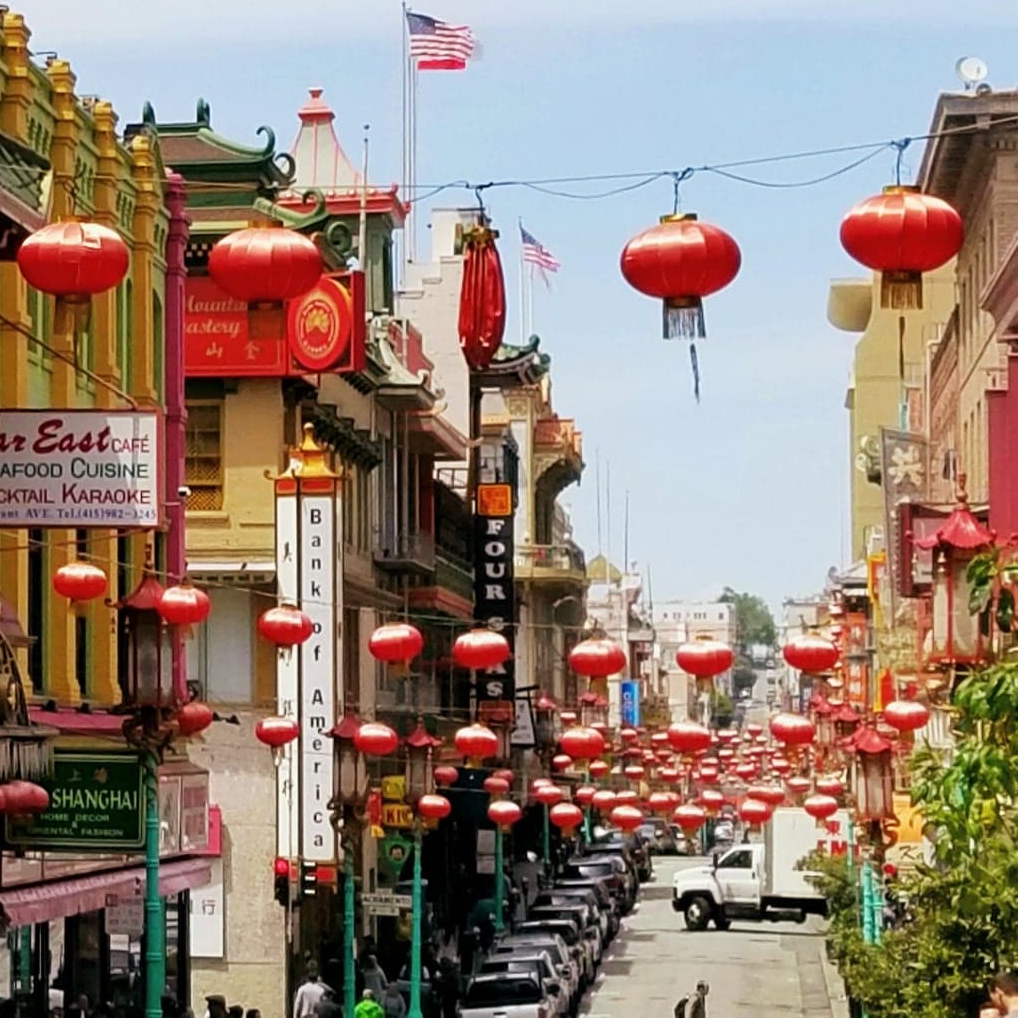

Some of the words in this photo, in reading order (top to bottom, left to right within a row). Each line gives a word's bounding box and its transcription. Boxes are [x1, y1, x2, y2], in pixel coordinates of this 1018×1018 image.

[32, 418, 111, 455] East
[111, 434, 150, 454] CAFÉ
[70, 457, 149, 479] CUISINE
[62, 483, 151, 505] KARAOKE
[310, 508, 323, 597] Bank
[484, 519, 507, 600] FOUR
[311, 622, 323, 661] of
[486, 617, 505, 697] SAS
[309, 688, 325, 848] America
[51, 787, 138, 811] SHANGHAI
[28, 825, 76, 836] IENTAL
[80, 827, 124, 837] FASHION
[40, 813, 70, 823] HOME
[75, 813, 110, 824] DECOR
[363, 895, 411, 905] ACRAMENTO
